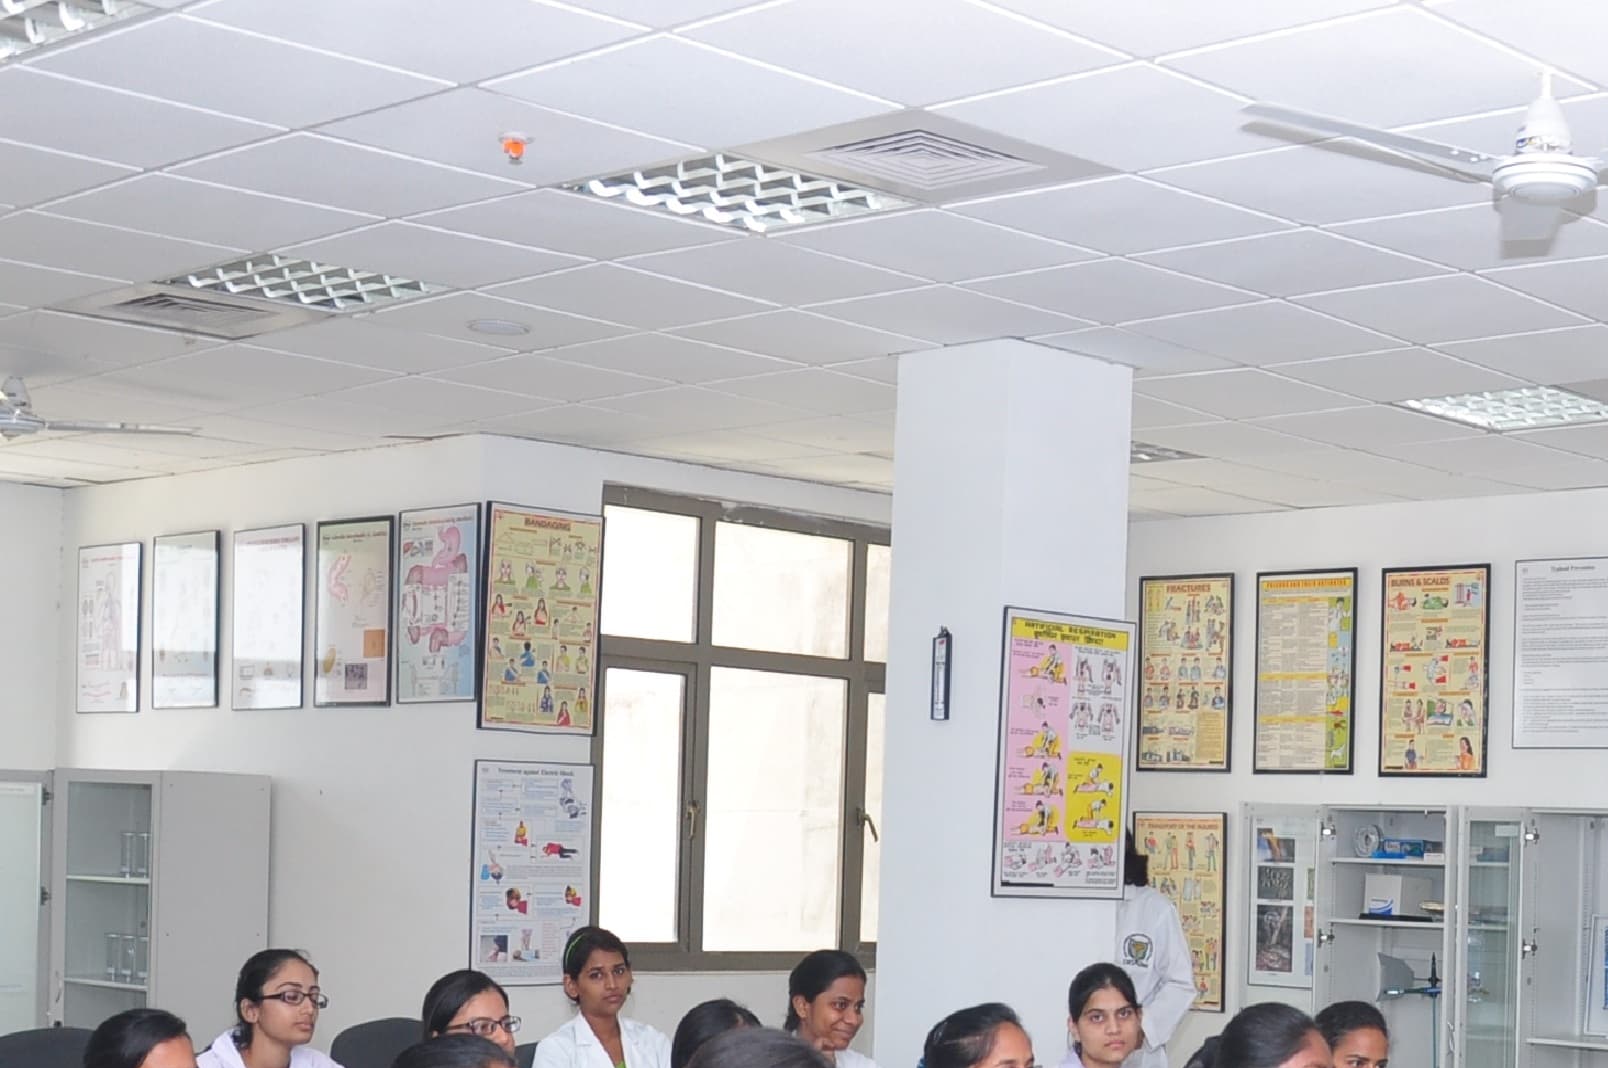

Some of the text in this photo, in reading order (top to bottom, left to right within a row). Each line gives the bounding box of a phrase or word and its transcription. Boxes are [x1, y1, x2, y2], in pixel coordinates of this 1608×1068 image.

[1423, 576, 1449, 586] SCALDS
[1167, 584, 1211, 592] FRACTURES
[1068, 626, 1117, 639] RESPIRATION
